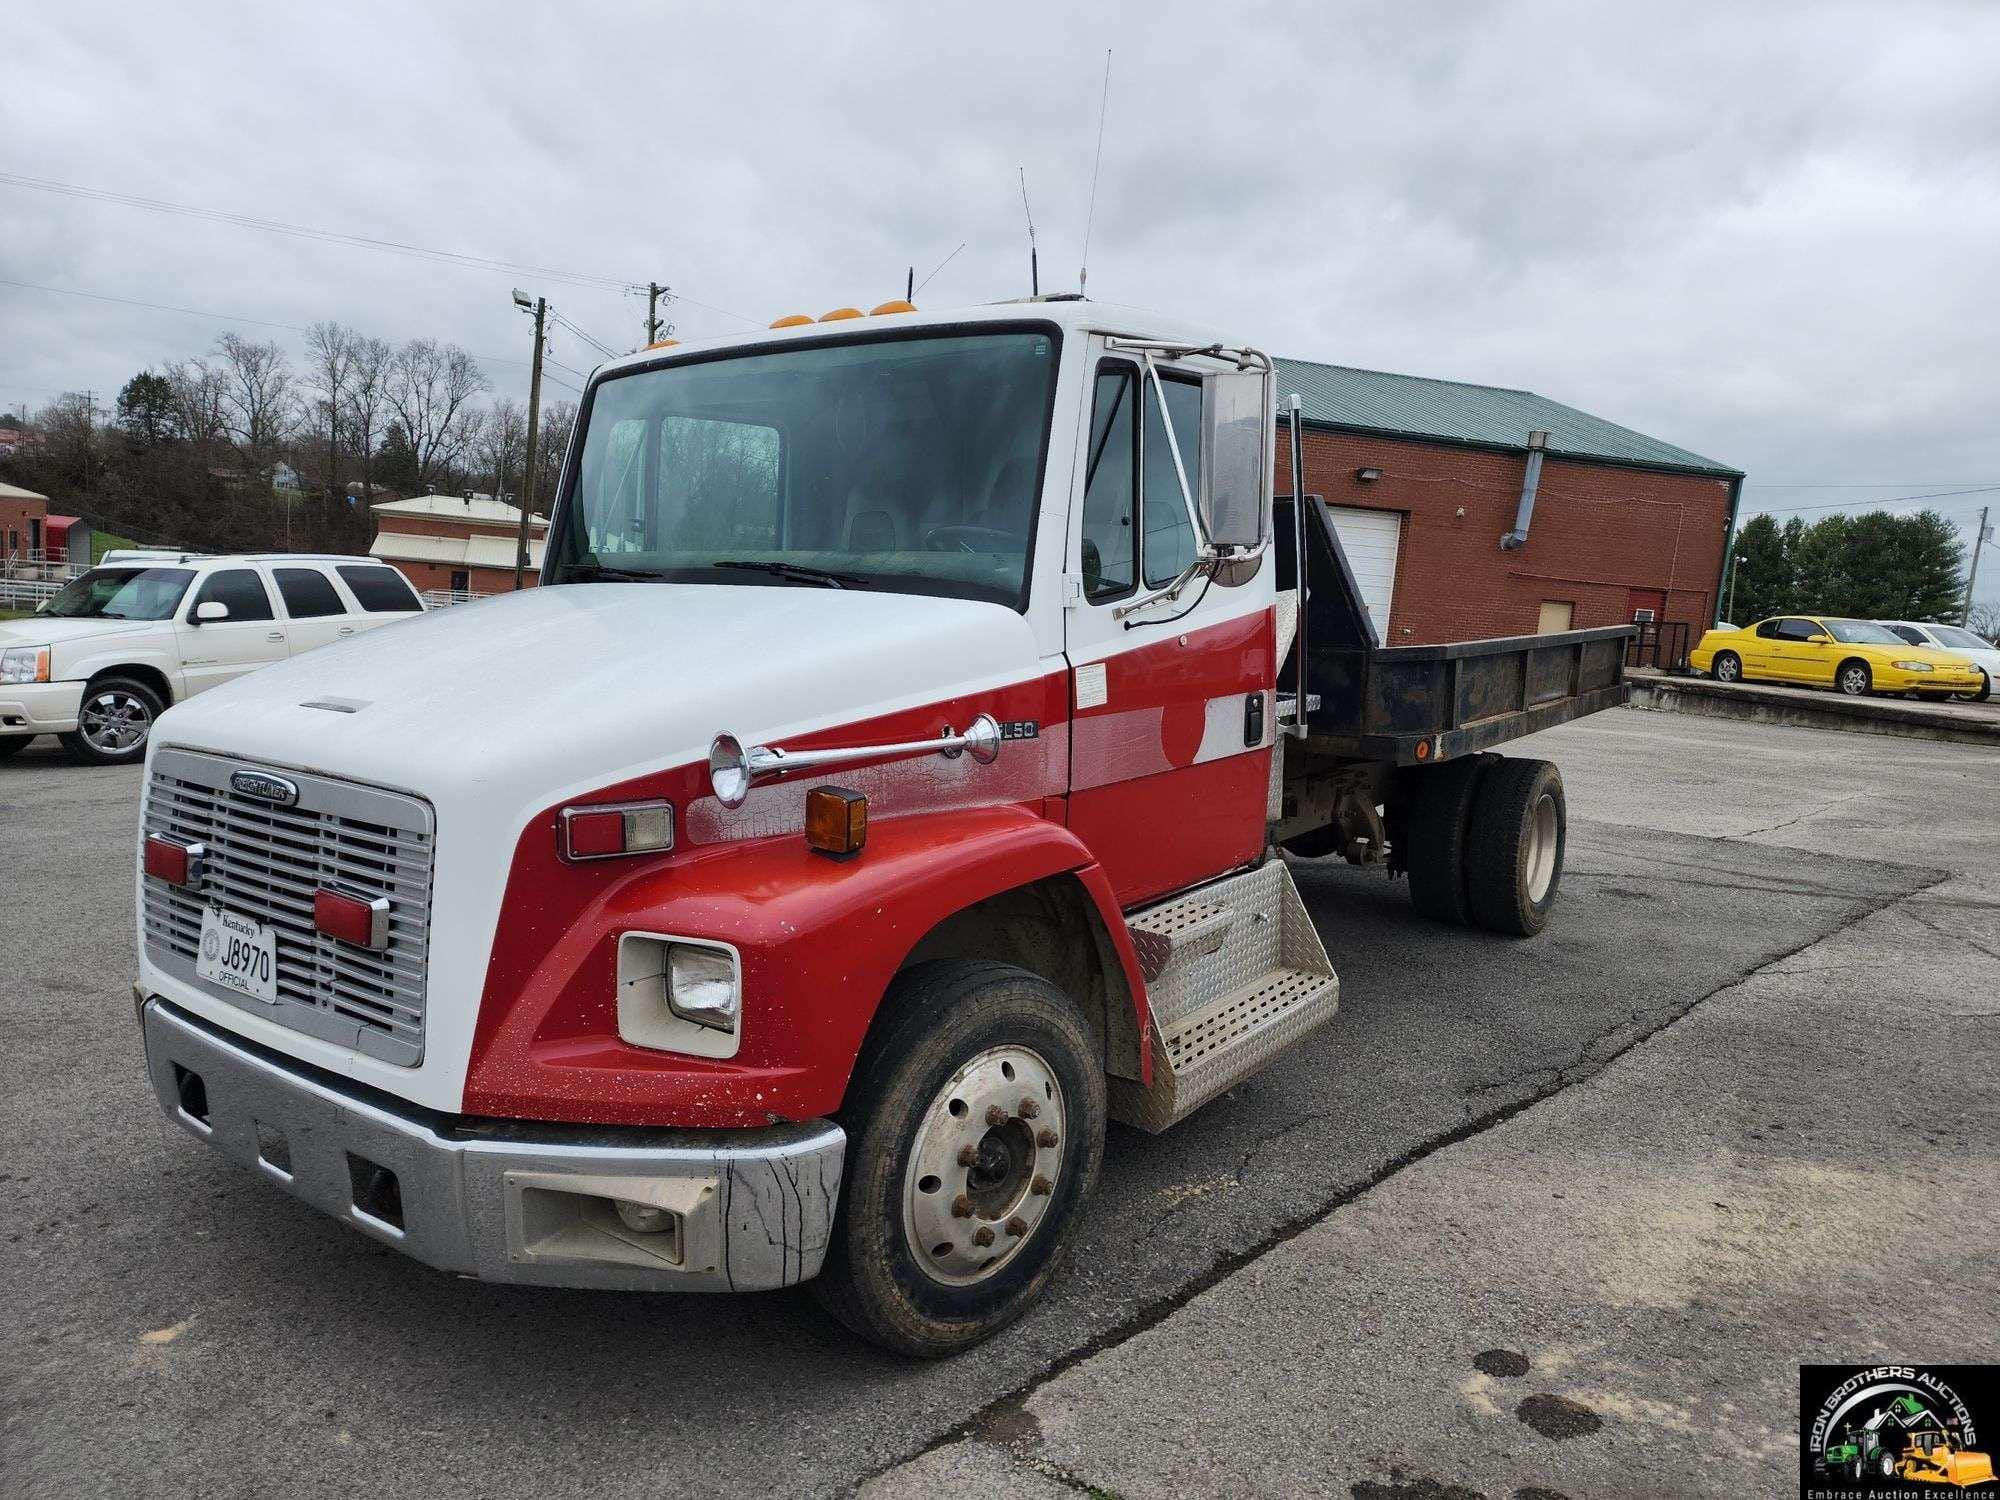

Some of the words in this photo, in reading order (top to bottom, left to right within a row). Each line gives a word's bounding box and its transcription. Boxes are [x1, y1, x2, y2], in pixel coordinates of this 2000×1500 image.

[222, 914, 255, 939] Kentucky
[221, 936, 269, 982] J8970
[219, 970, 250, 991] OFFICIAL
